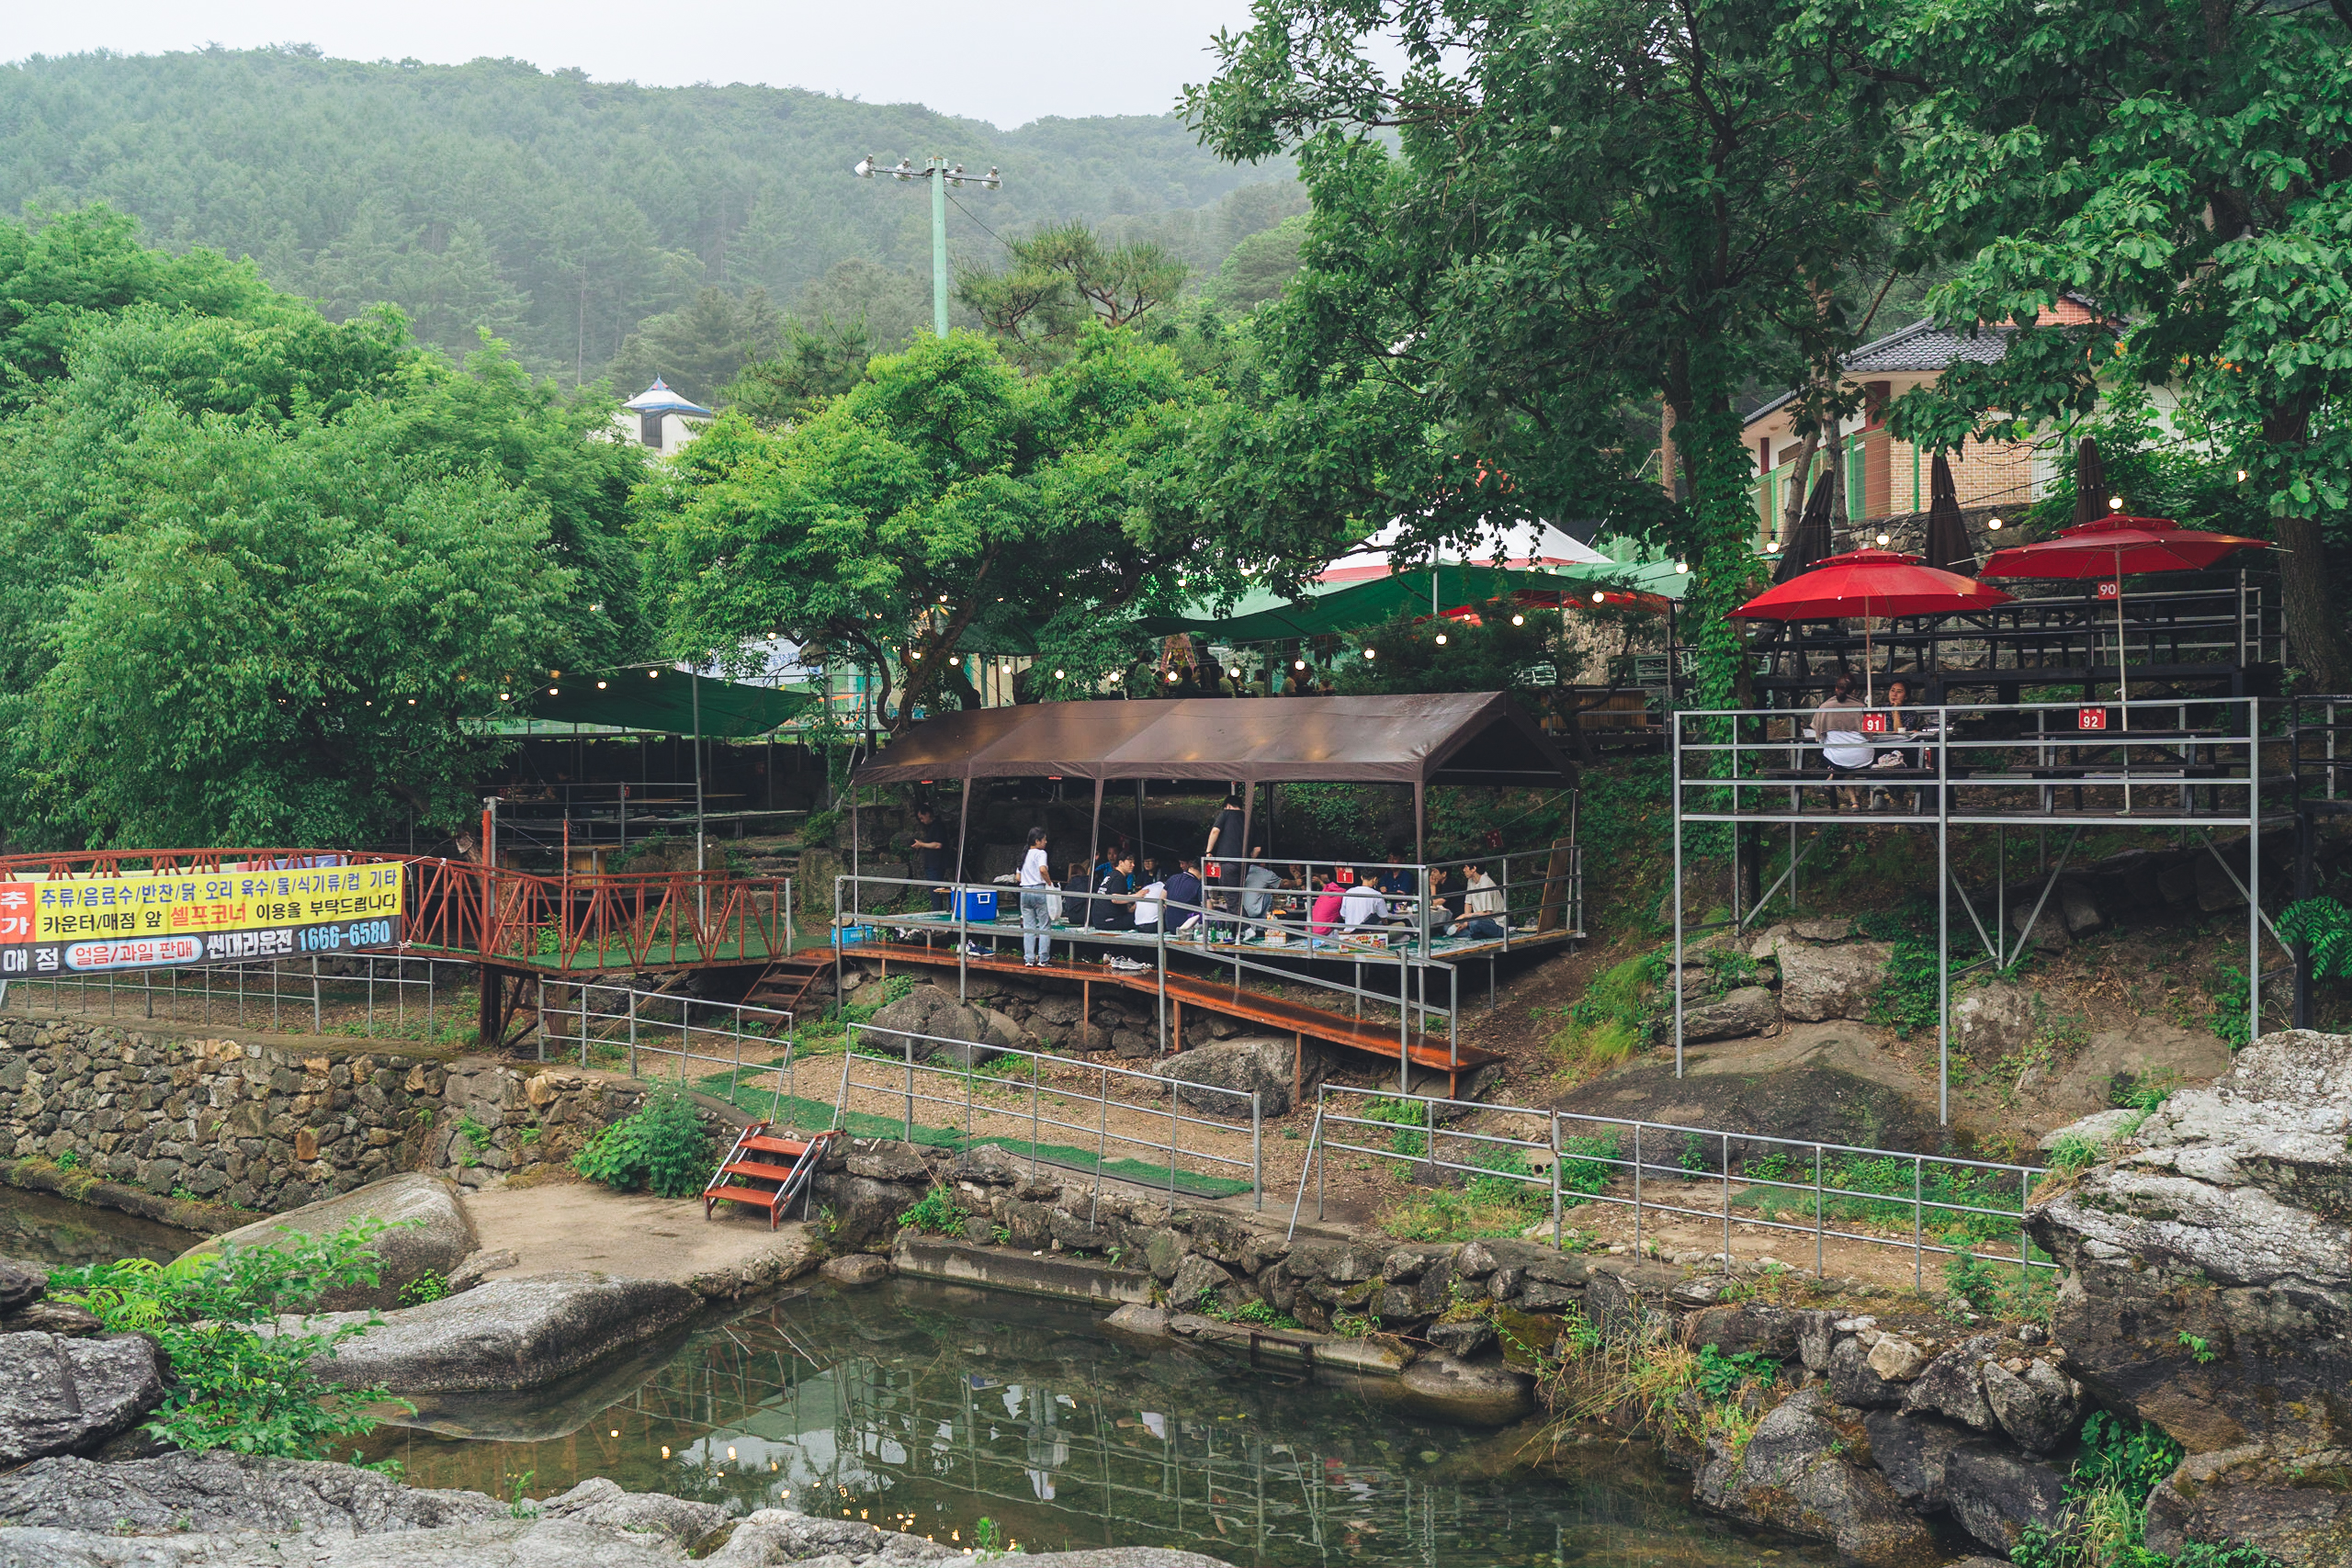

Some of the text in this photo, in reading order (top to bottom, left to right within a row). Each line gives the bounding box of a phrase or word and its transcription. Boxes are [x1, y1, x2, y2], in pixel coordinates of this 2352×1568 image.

[2099, 583, 2117, 595] 90
[1867, 719, 1880, 731] 91
[2083, 716, 2098, 728] 92
[1210, 866, 1216, 875] 3
[242, 873, 359, 897] 육수/물/식기류/컵
[370, 869, 397, 888] 기타
[43, 893, 397, 934] 카운터/매점 앞 셀프코너 이용을 부탁드립니다
[207, 919, 390, 960] 썬대리운전 1666-6580
[75, 941, 193, 966] 얼음/과일 판매
